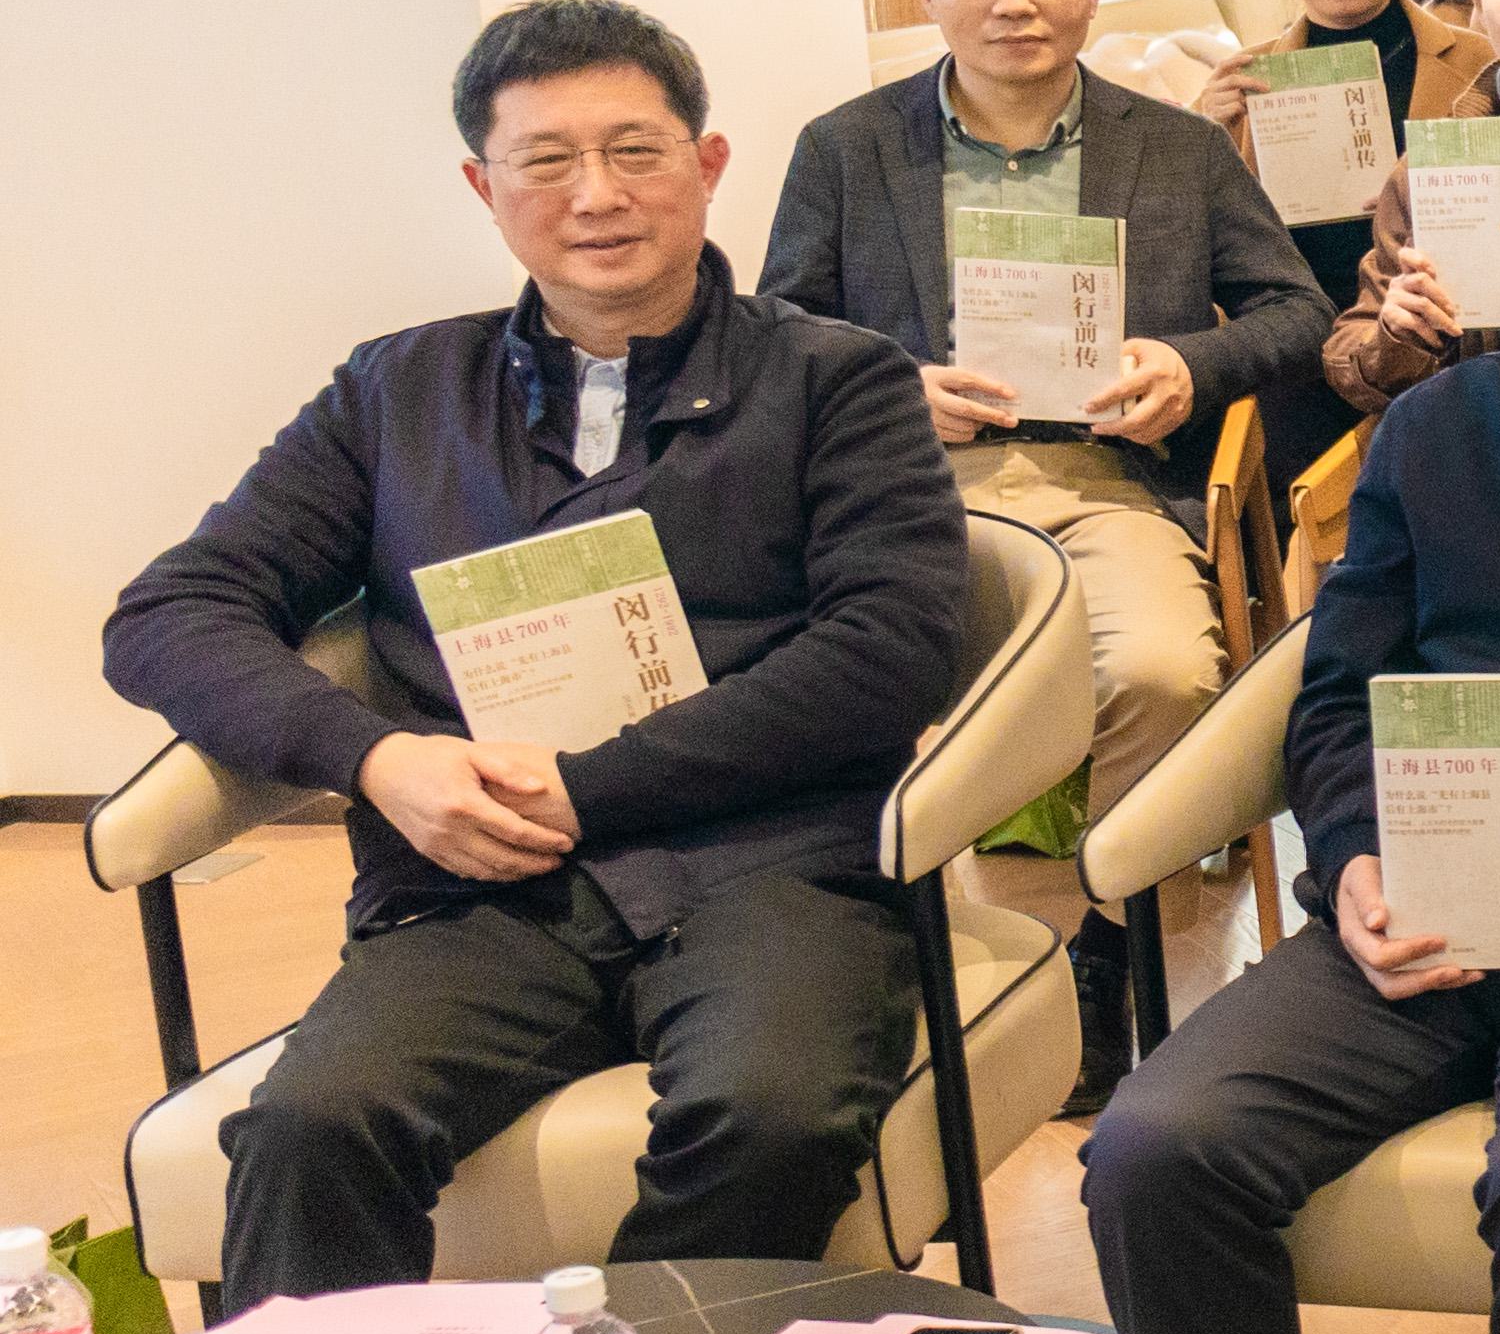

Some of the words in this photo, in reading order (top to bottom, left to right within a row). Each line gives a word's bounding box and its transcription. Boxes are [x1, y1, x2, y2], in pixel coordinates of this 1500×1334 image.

[1344, 86, 1377, 169] 闵行前传
[1414, 173, 1494, 189] 上海县700年
[1072, 270, 1100, 370] 闵行前传
[452, 611, 572, 653] 上海县700年
[1383, 758, 1498, 776] 上海县700年
